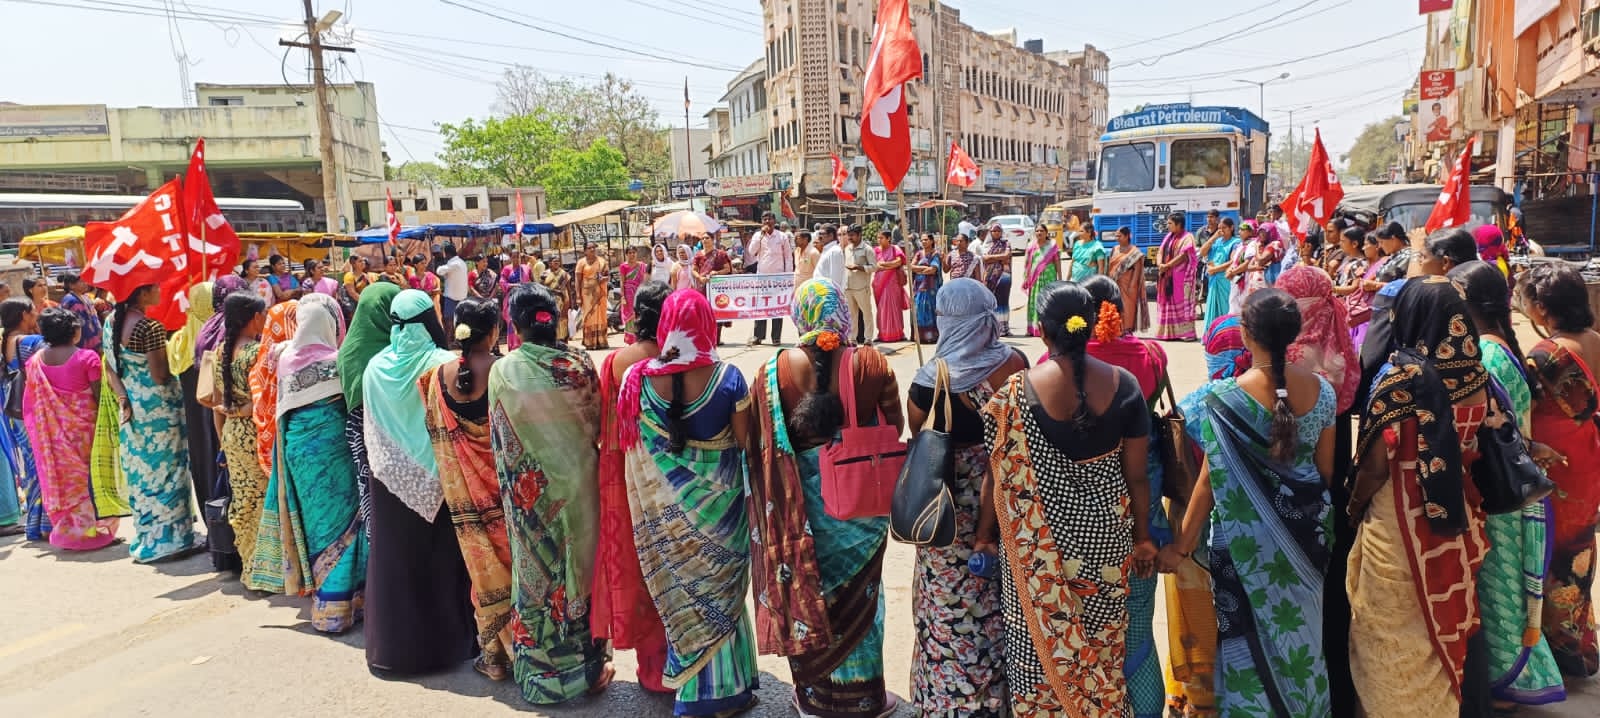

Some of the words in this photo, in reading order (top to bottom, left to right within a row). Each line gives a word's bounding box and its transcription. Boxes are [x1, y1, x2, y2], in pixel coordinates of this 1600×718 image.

[1113, 113, 1157, 130] Bharat
[1158, 109, 1221, 123] Petroleum
[868, 190, 886, 201] OUT
[1151, 205, 1171, 213] TATA
[734, 294, 788, 307] CITU
